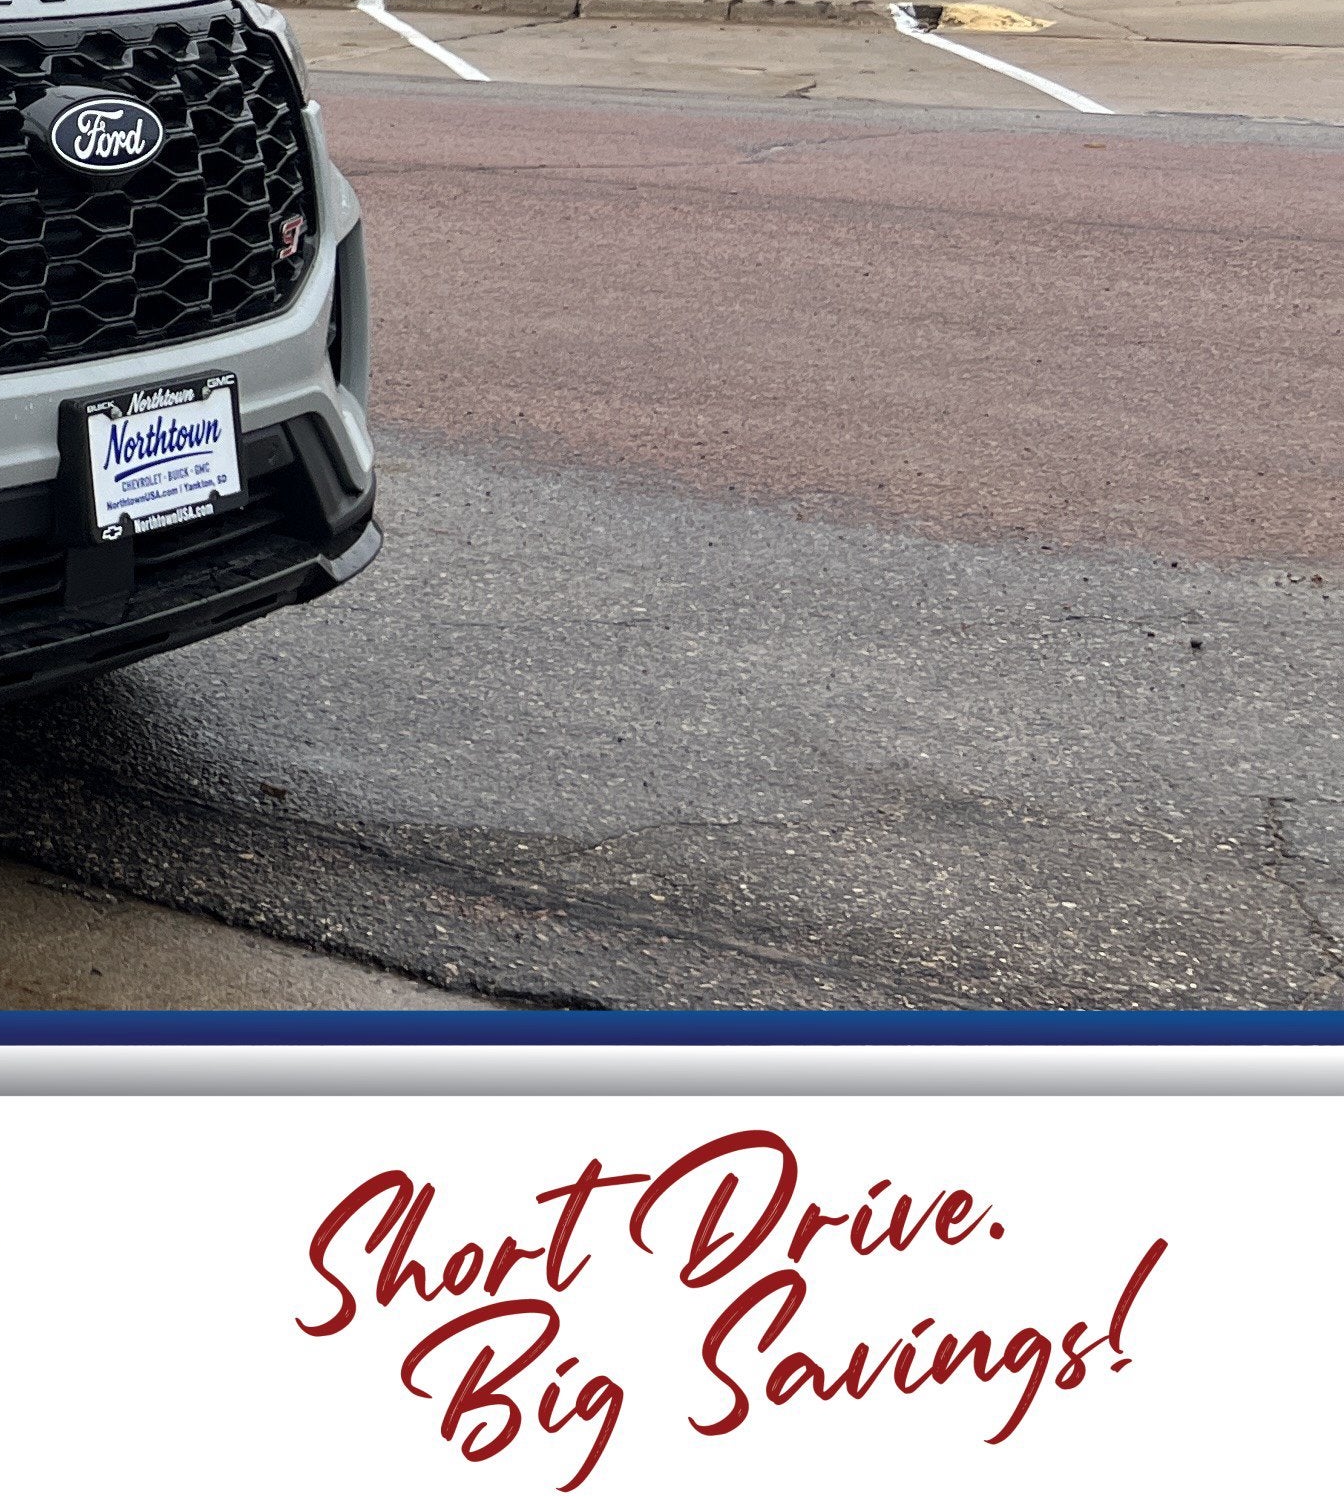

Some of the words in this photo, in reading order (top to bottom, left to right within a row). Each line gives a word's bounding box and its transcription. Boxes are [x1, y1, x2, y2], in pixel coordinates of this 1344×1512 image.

[74, 107, 146, 161] Ford
[86, 400, 114, 414] BUICK
[127, 388, 195, 416] Northtown
[206, 375, 234, 388] GMC
[103, 415, 222, 470] Northtown
[106, 487, 179, 511] NorthtownUSA.com
[217, 474, 227, 484] SD
[121, 472, 162, 492] CHEVROLET
[167, 468, 189, 482] BUICK
[194, 462, 210, 474] GMC
[133, 503, 214, 534] NorthtownUSA.com
